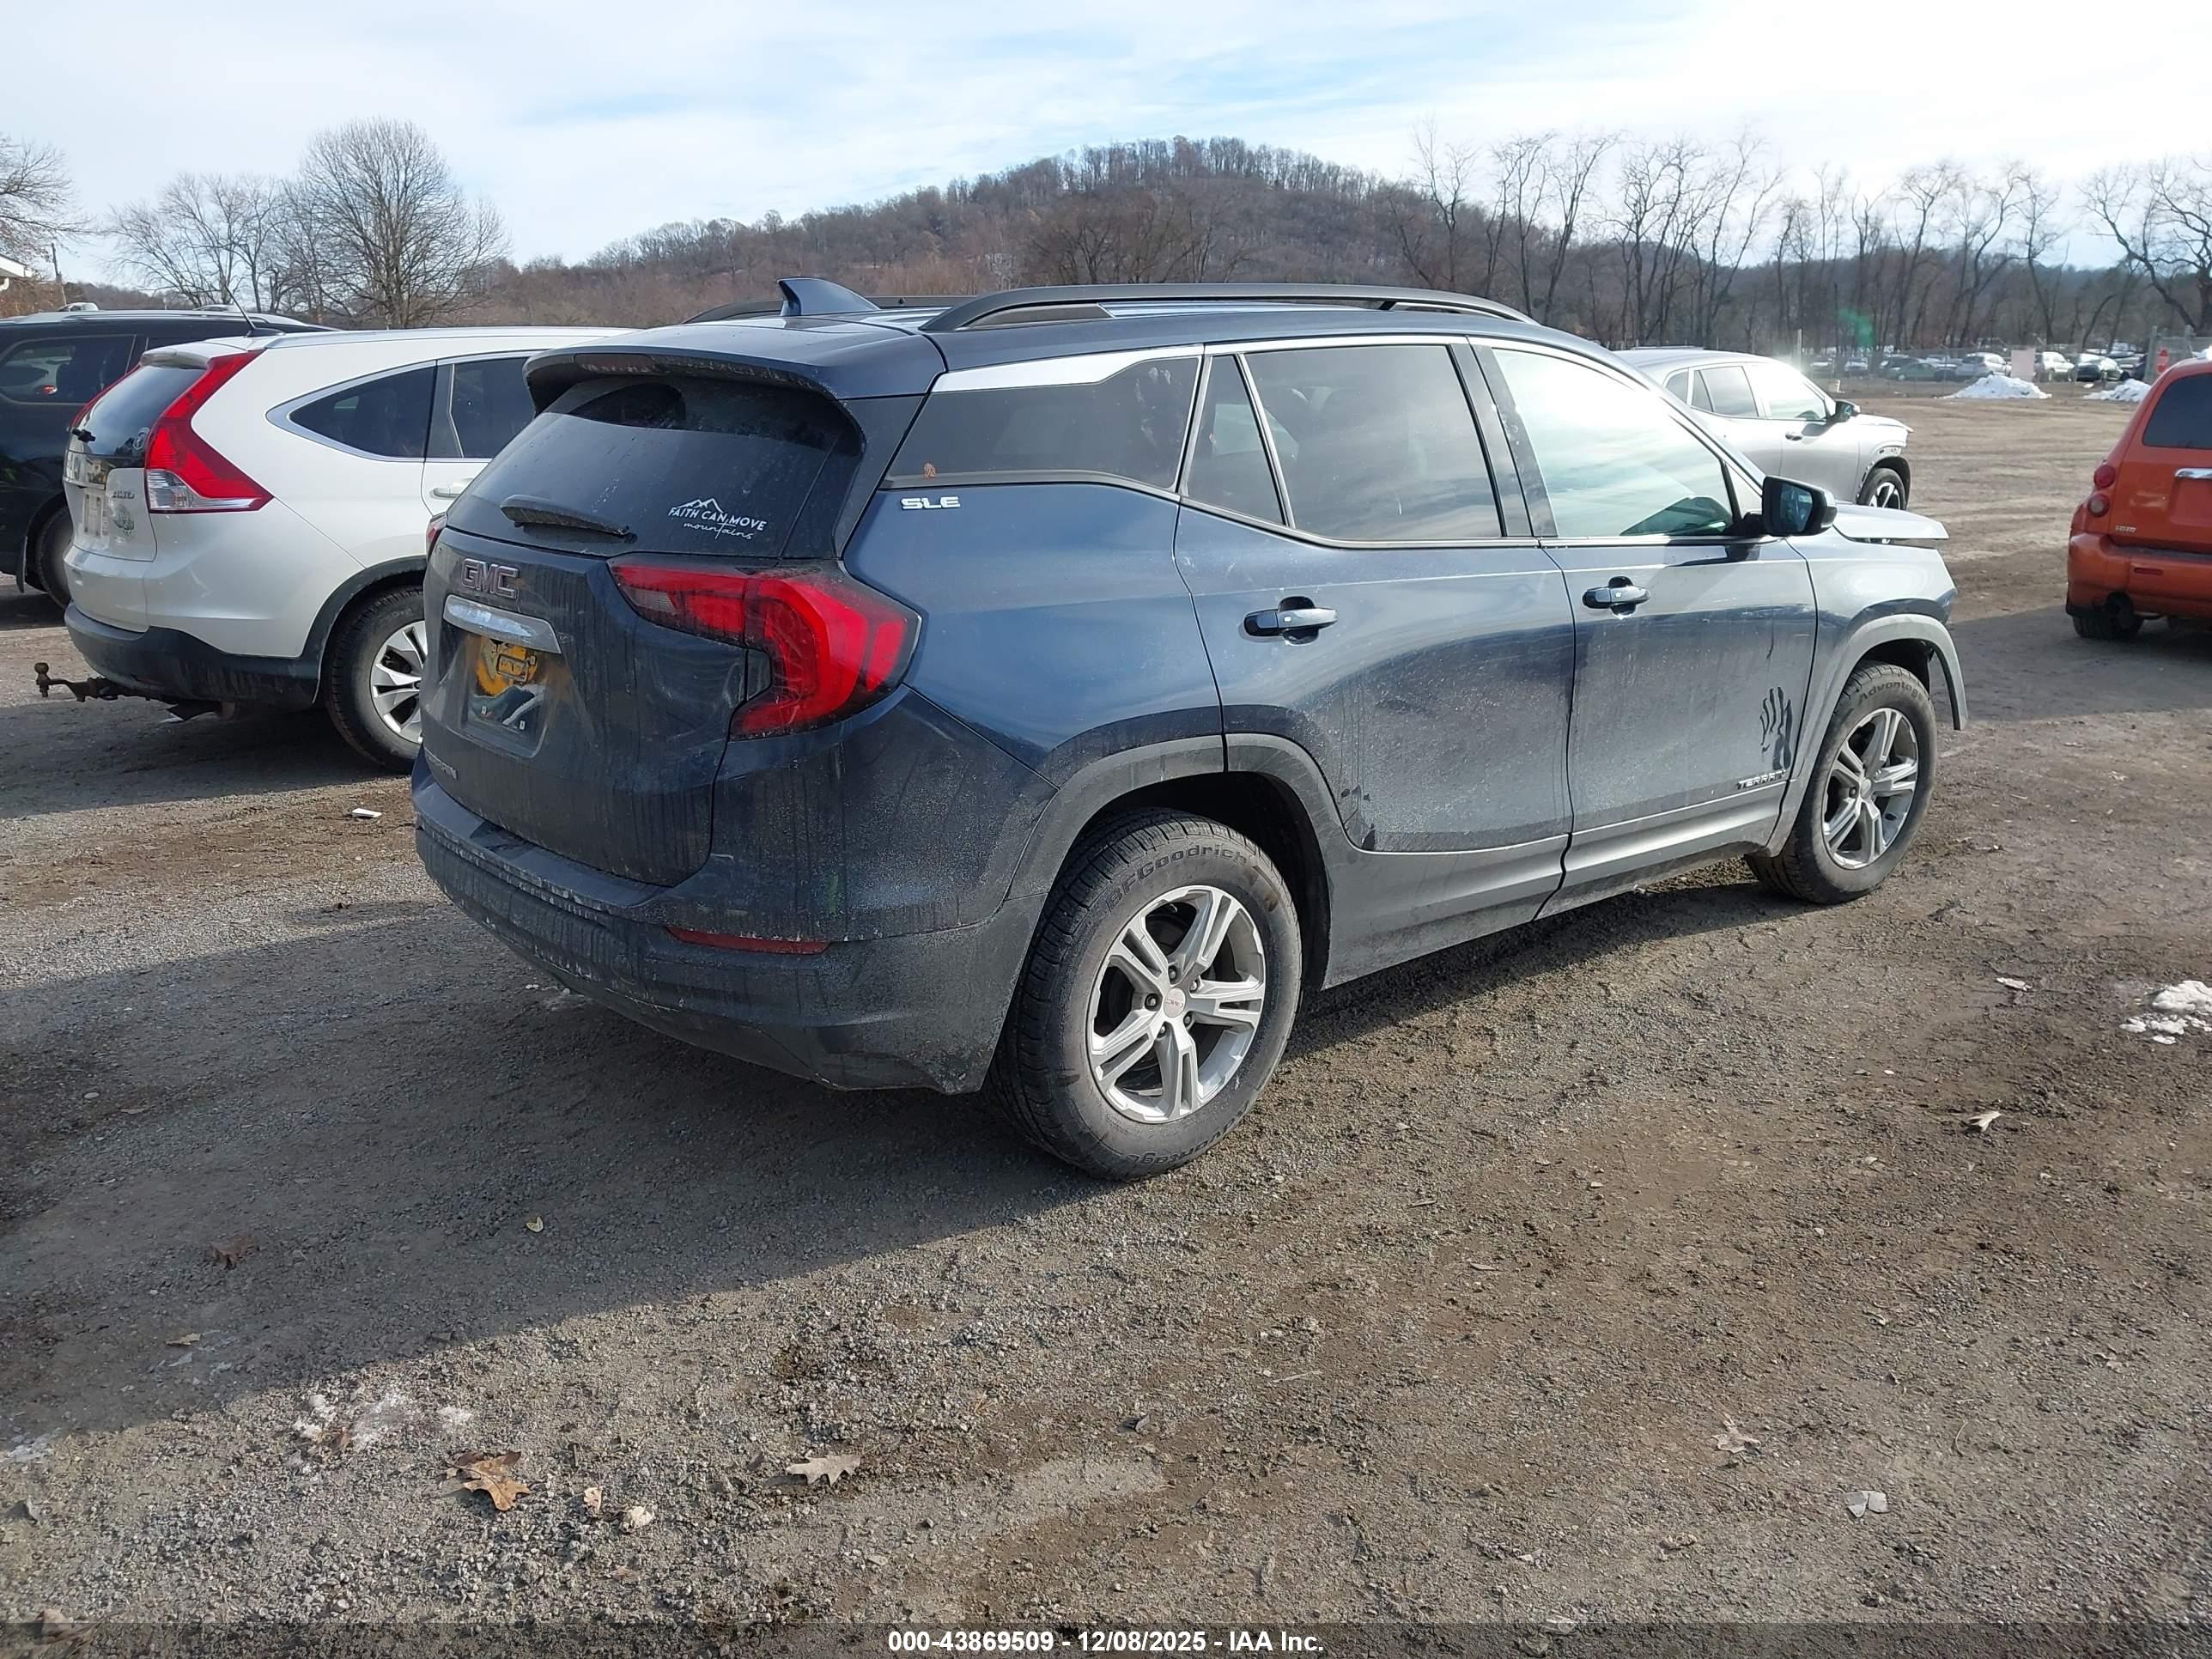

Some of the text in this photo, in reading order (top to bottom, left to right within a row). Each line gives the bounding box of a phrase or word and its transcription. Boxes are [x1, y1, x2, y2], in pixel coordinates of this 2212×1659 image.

[901, 496, 961, 509] SLE
[668, 507, 767, 531] FAITH CAN MOVE
[684, 520, 754, 539] mountains
[462, 558, 519, 599] GMC
[1105, 844, 1248, 913] BFGoodrich
